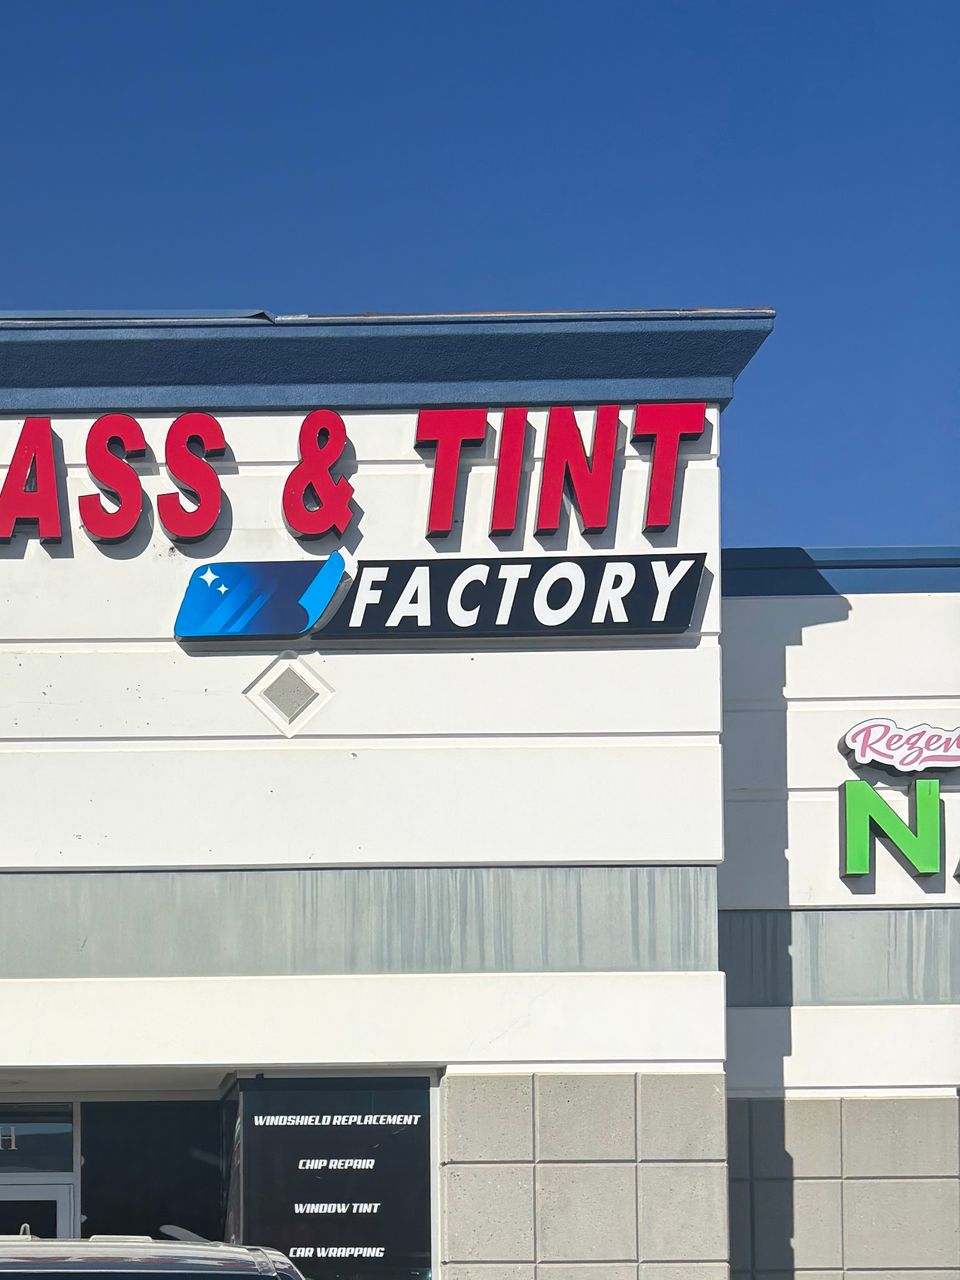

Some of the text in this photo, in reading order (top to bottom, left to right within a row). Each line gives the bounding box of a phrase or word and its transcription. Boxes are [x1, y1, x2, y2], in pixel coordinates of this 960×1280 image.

[283, 409, 355, 538] &
[414, 403, 707, 536] TINT
[348, 560, 696, 628] FACTORY
[254, 1114, 421, 1126] WINDSHIELD REPLACEMENT
[298, 1159, 375, 1170] CHIP REPAIR
[294, 1203, 381, 1214] WINDOW TINT
[289, 1247, 385, 1258] CAR WRAPPING
